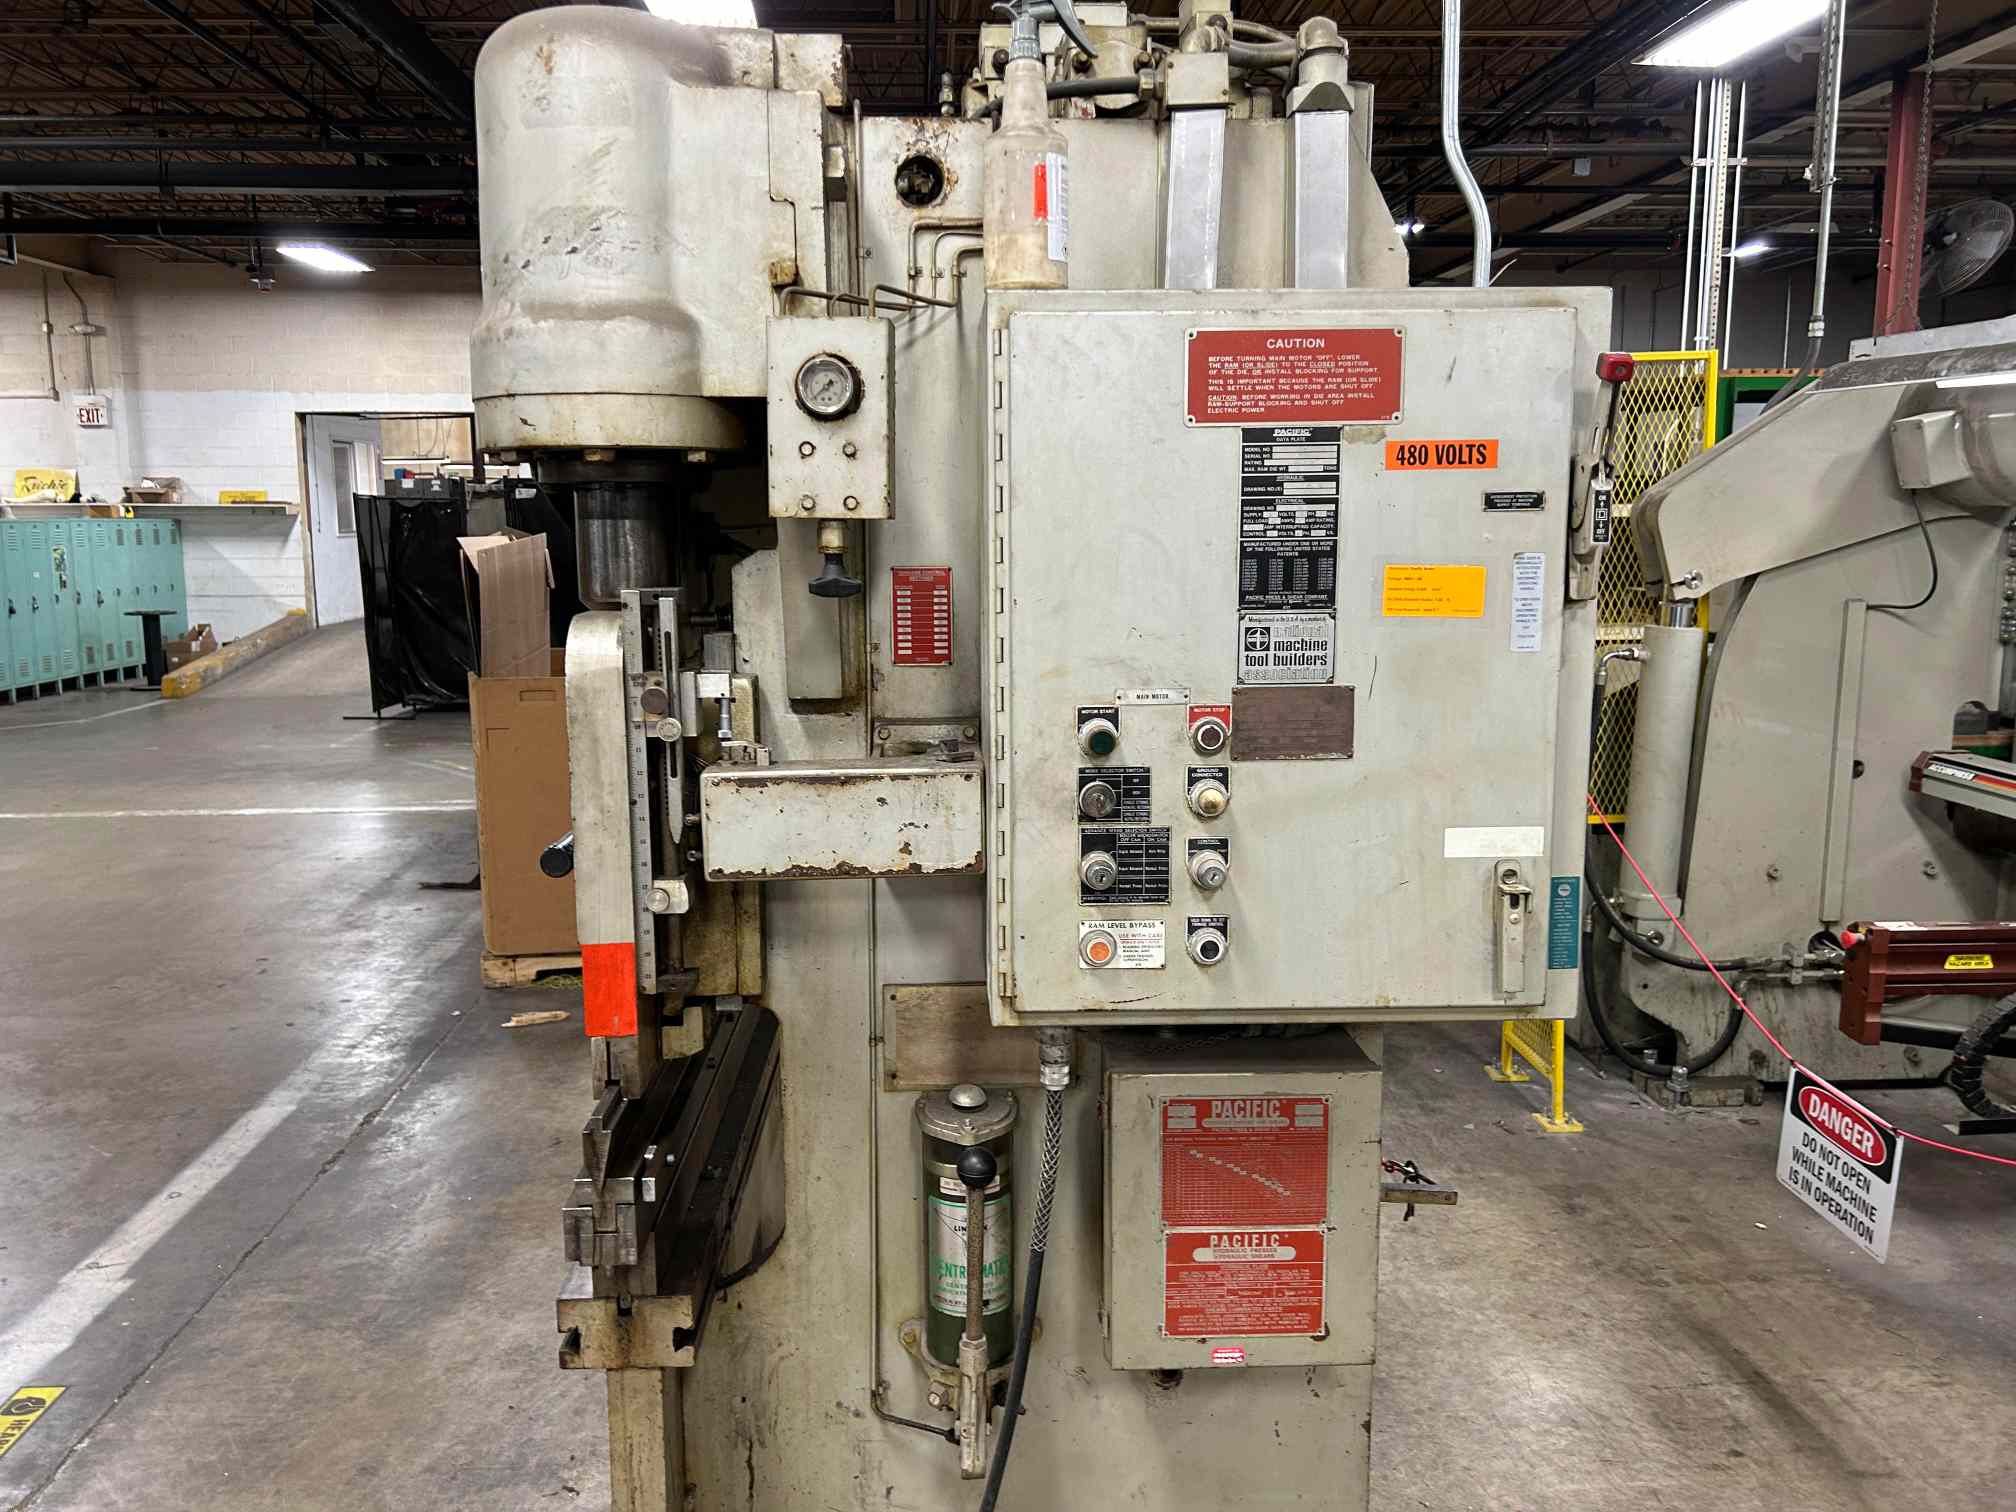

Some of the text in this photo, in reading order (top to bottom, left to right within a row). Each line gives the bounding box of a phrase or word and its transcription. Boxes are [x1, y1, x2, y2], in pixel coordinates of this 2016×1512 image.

[1266, 338, 1325, 349] CAUTION
[79, 407, 100, 425] EXIT
[1395, 443, 1488, 465] 480 VOLTS
[1274, 638, 1328, 652] machine
[1245, 652, 1328, 667] tool builders
[1212, 1100, 1280, 1118] PACIFIC
[1808, 1093, 1874, 1158] DANGER
[1802, 1132, 1871, 1194] DO NOT OPEN
[1792, 1145, 1877, 1223] WHILE MACHINE
[1789, 1166, 1874, 1244] IS IN OPERATION
[1210, 1234, 1280, 1248] PACIFIC
